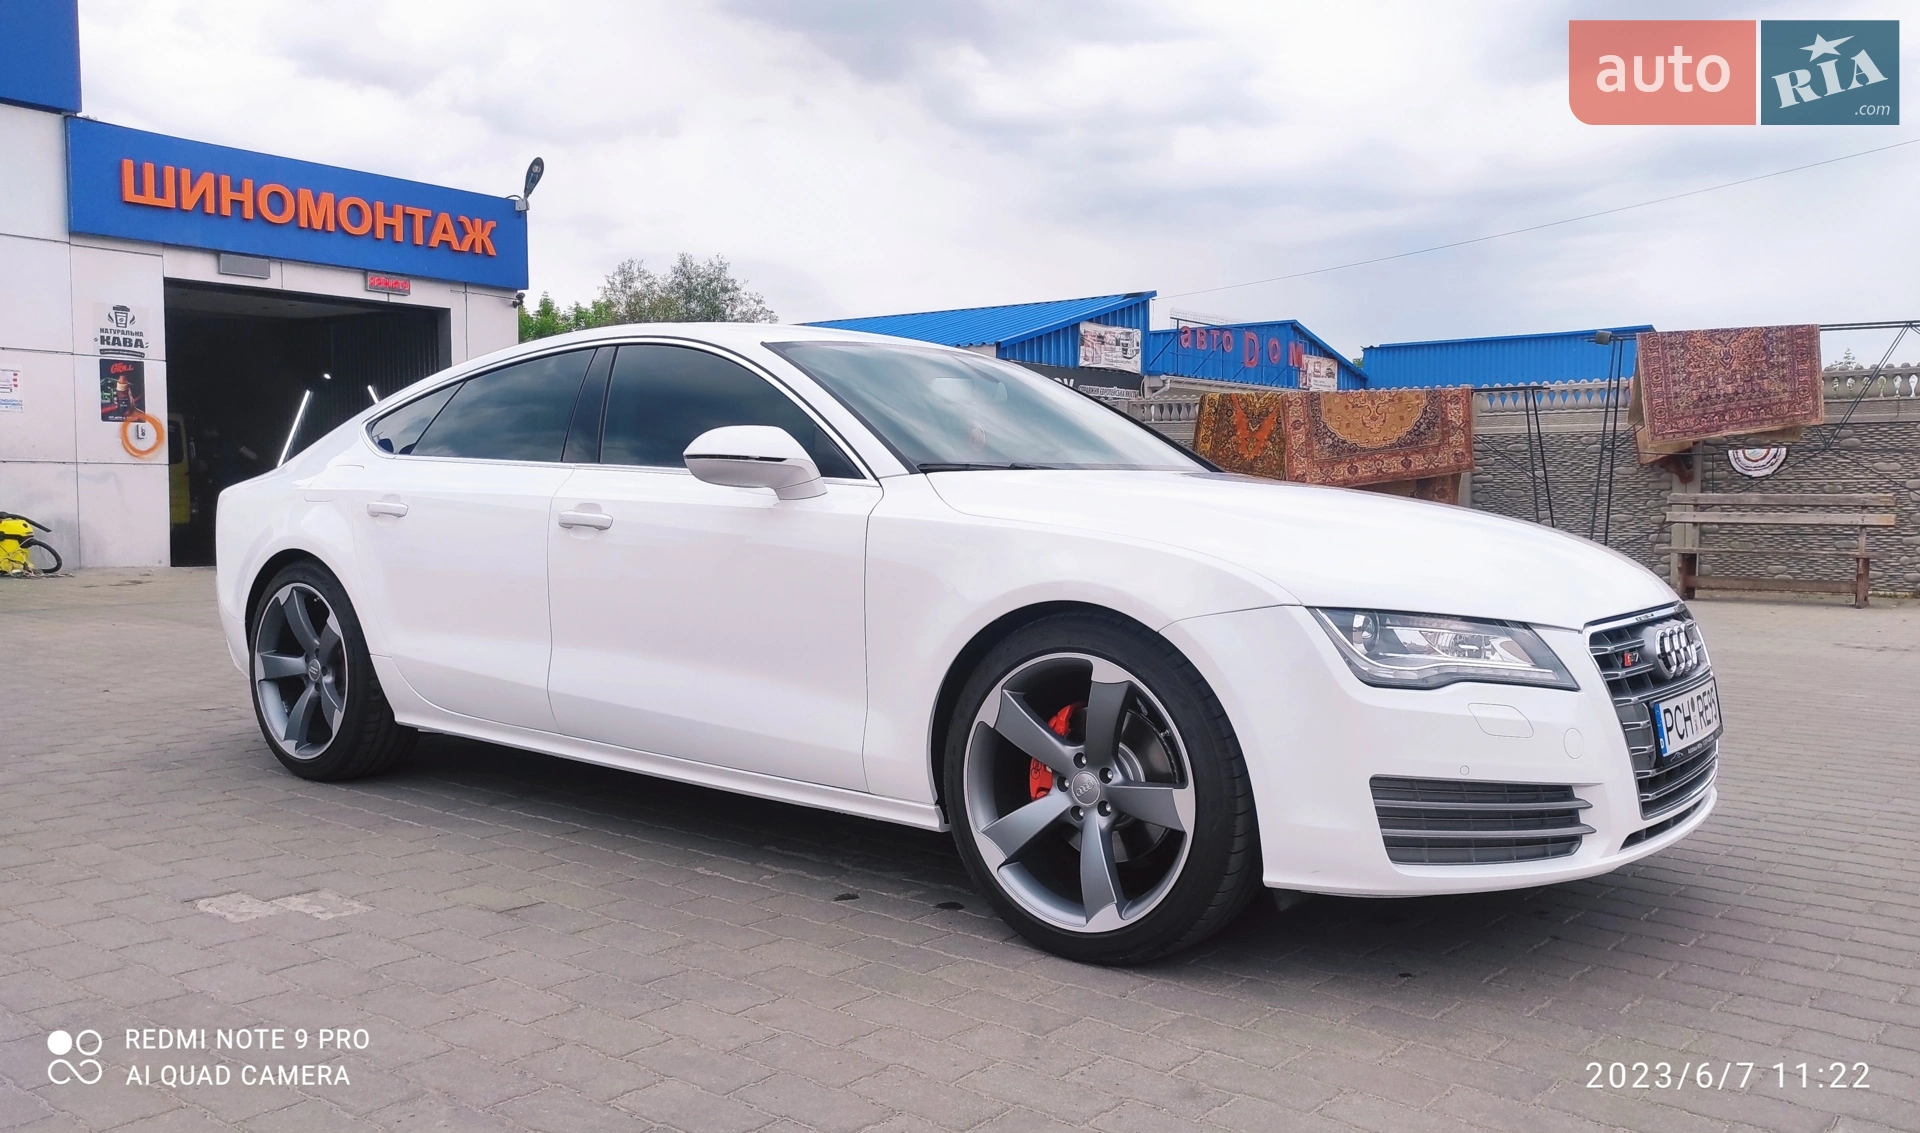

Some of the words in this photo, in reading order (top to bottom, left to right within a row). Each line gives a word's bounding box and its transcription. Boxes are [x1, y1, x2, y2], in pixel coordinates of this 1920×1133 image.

[121, 158, 498, 257] ШИНОМОНТАЖ
[99, 327, 144, 338] НАТУРАЛЬНА
[99, 335, 145, 349] КАВА
